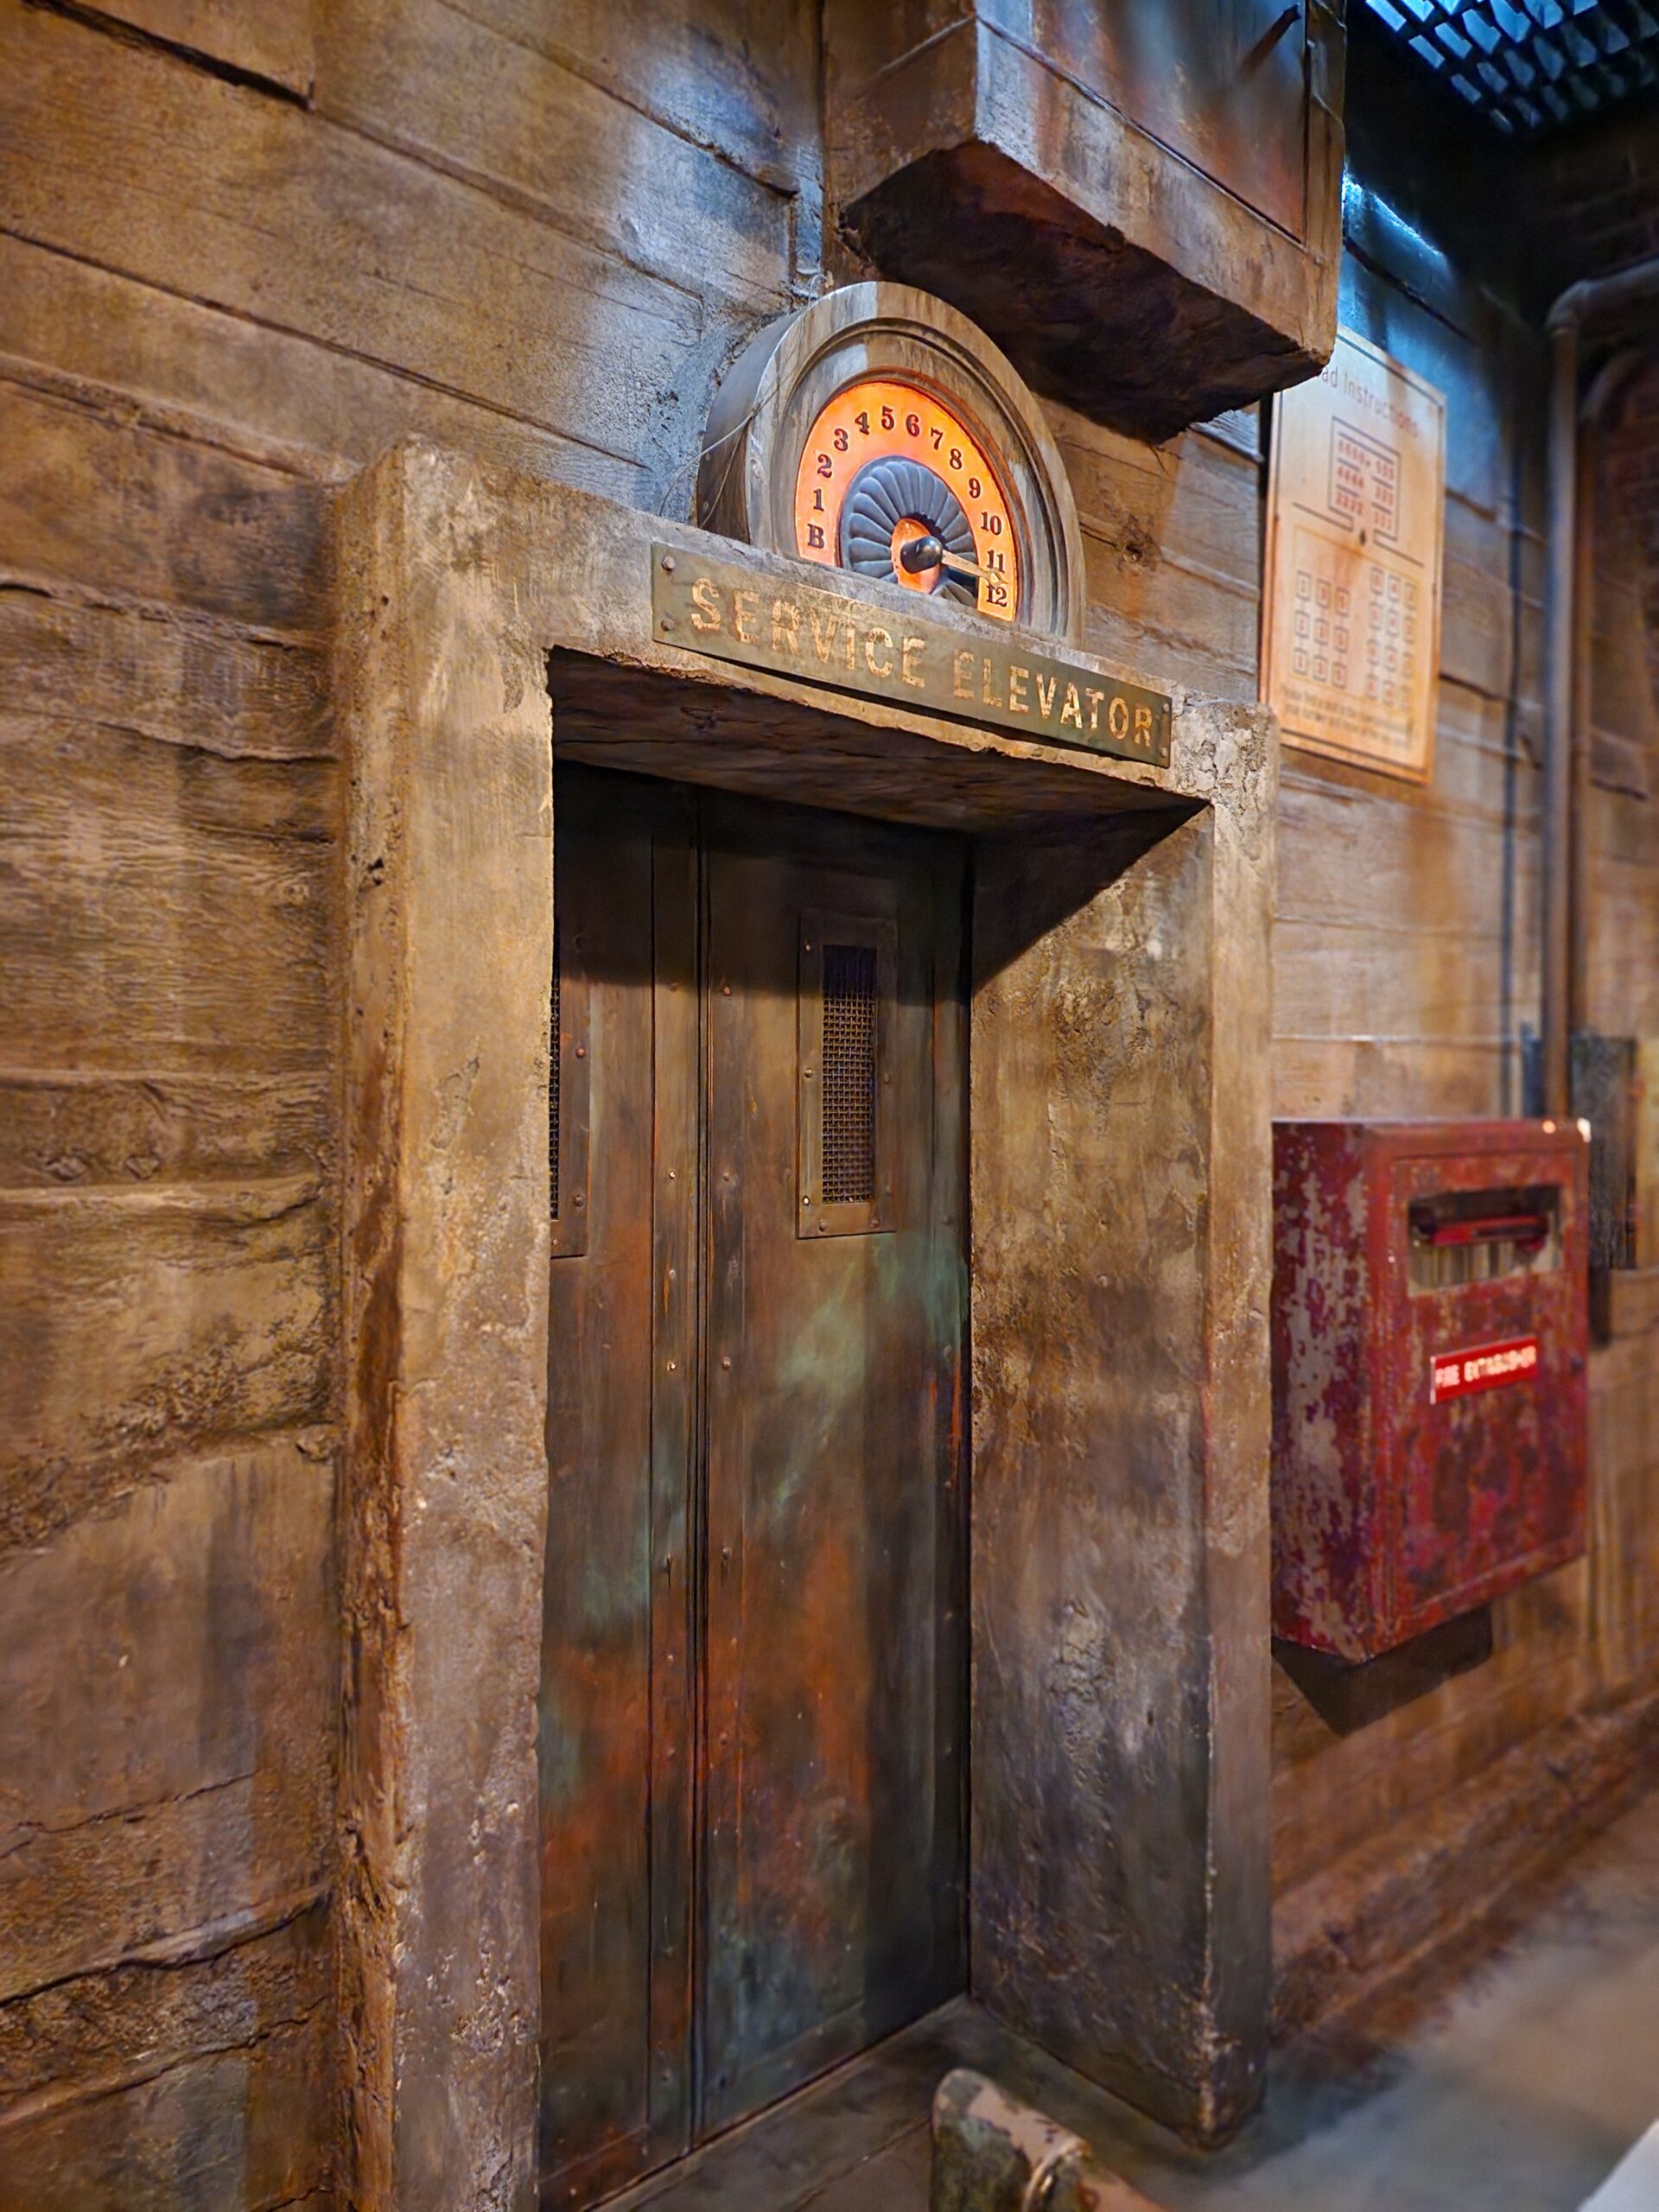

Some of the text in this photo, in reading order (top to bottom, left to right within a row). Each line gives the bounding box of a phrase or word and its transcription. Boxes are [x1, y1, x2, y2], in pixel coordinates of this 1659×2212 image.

[807, 405, 1007, 607] B 1 2 3 4 5 6 7 8 9 10 11 12
[690, 577, 1153, 747] SERVICE ELEVATOR
